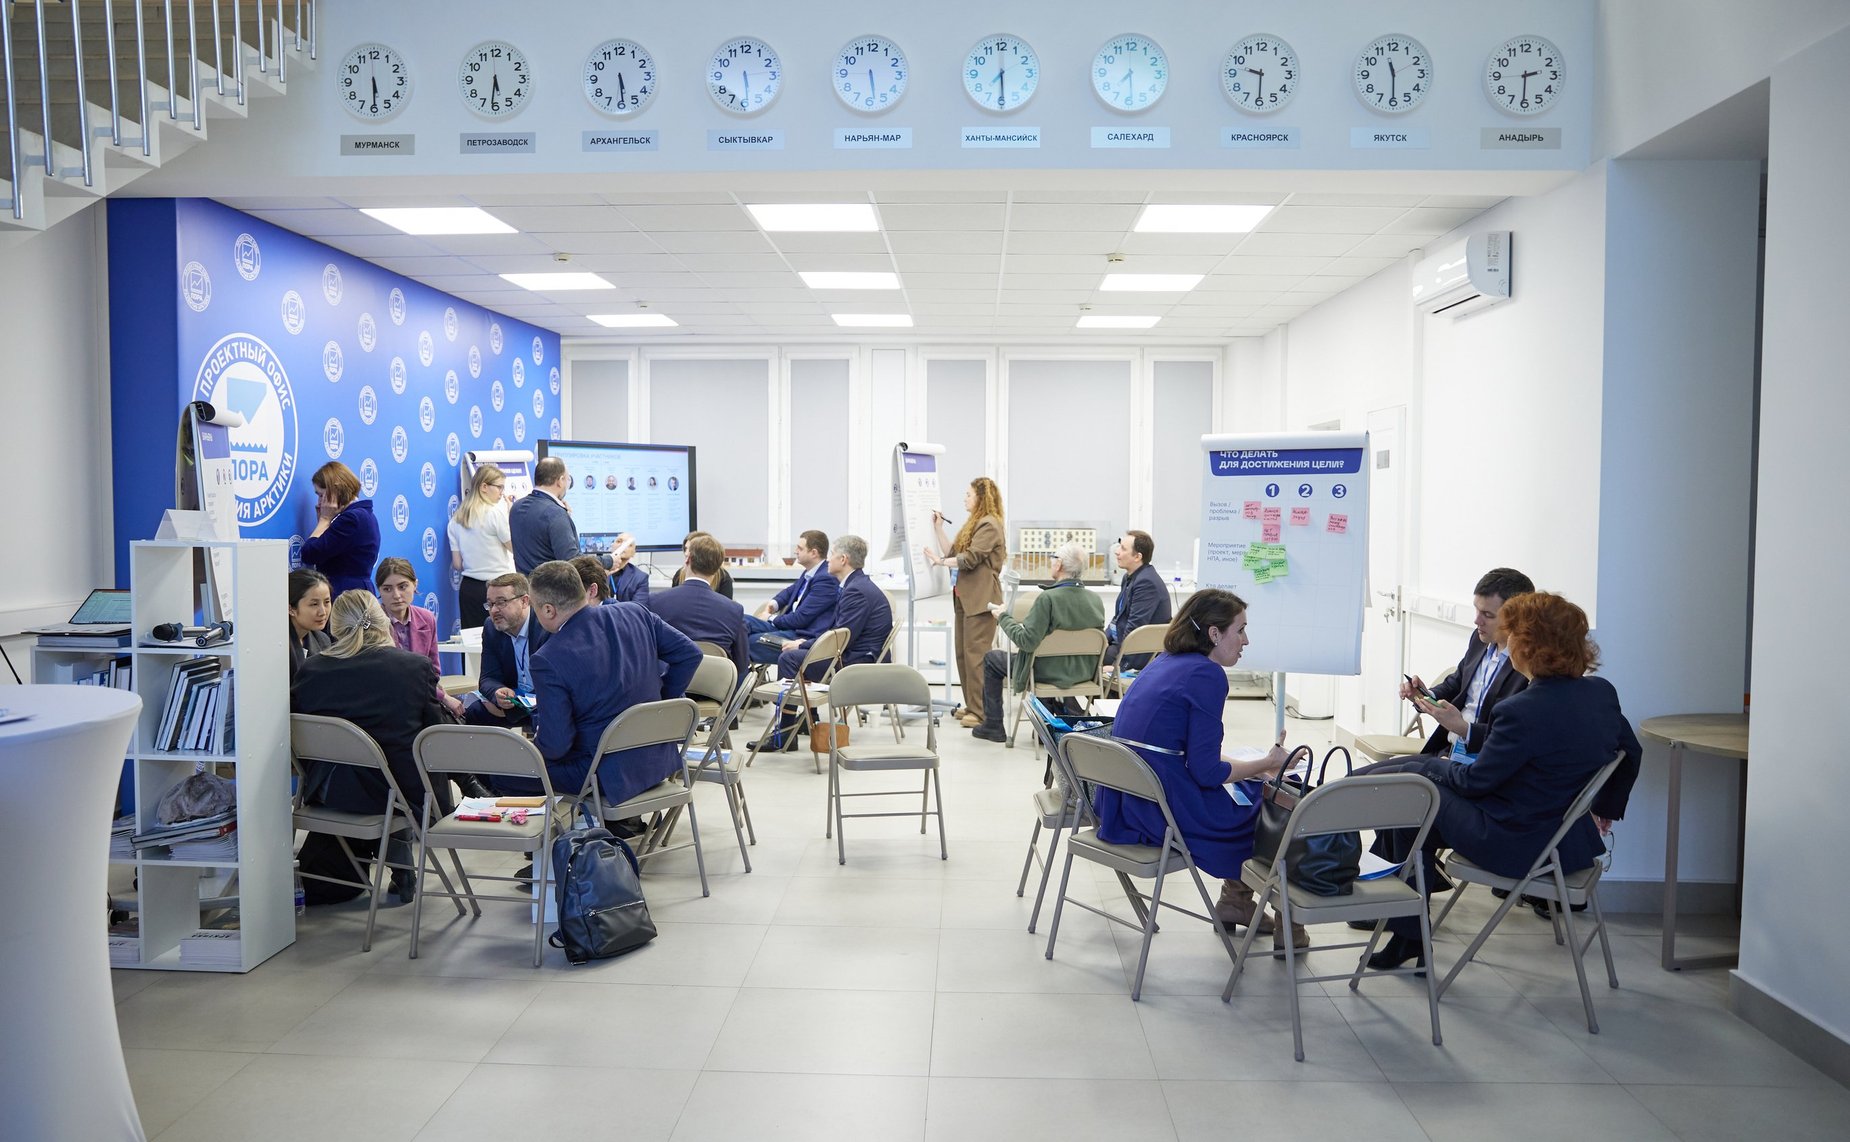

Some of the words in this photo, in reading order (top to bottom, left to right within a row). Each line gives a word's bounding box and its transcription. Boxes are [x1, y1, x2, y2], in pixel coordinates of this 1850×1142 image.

[614, 46, 625, 55] 12
[740, 44, 751, 53] 12
[855, 47, 863, 55] 11
[867, 43, 878, 52] 12
[984, 46, 992, 55] 11
[996, 42, 1007, 51] 12
[1013, 46, 1017, 55] 1
[1113, 45, 1122, 54] 11
[1125, 42, 1137, 51] 12
[1143, 46, 1147, 56] 1
[1244, 46, 1252, 55] 11
[1256, 42, 1267, 51] 12
[1387, 42, 1399, 51] 12
[1404, 46, 1408, 55] 1
[1520, 43, 1531, 52] 12
[368, 51, 380, 60] 12
[490, 48, 501, 57] 12
[602, 52, 611, 60] 11
[631, 50, 635, 59] 1
[728, 49, 736, 58] 11
[757, 49, 761, 57] 1
[884, 48, 888, 56] 1
[1273, 47, 1277, 56] 1
[1375, 47, 1384, 56] 11
[1507, 48, 1516, 57] 11
[1537, 48, 1541, 56] 1
[358, 55, 365, 64] 11
[385, 54, 389, 63] 1
[479, 53, 487, 62] 11
[507, 52, 510, 61] 1
[845, 56, 856, 65] 10
[974, 56, 985, 65] 10
[1021, 56, 1028, 65] 2
[1103, 55, 1114, 64] 10
[1233, 56, 1245, 65] 10
[1413, 56, 1420, 65] 2
[639, 59, 646, 68] 2
[718, 58, 730, 68] 10
[764, 58, 772, 67] 2
[891, 58, 898, 67] 2
[1150, 57, 1158, 66] 2
[1281, 57, 1288, 66] 2
[1365, 57, 1377, 66] 10
[1497, 58, 1509, 67] 10
[1545, 58, 1552, 67] 2
[348, 65, 359, 74] 10
[392, 64, 399, 73] 2
[469, 63, 480, 72] 10
[514, 62, 521, 71] 2
[593, 62, 604, 71] 10
[644, 72, 651, 81] 3
[714, 72, 722, 80] 9
[769, 71, 776, 80] 3
[840, 69, 848, 78] 9
[895, 71, 903, 80] 3
[969, 69, 978, 79] 9
[1026, 68, 1034, 78] 3
[1098, 68, 1107, 78] 9
[1154, 70, 1163, 79] 3
[1228, 68, 1237, 78] 9
[1285, 70, 1292, 80] 3
[1361, 70, 1369, 79] 9
[1418, 69, 1425, 78] 3
[1492, 71, 1501, 81] 9
[1550, 71, 1558, 80] 3
[344, 78, 352, 87] 9
[397, 77, 404, 86] 3
[465, 76, 473, 85] 9
[519, 75, 526, 84] 3
[590, 75, 598, 84] 9
[640, 86, 648, 94] 4
[719, 86, 726, 94] 8
[843, 82, 851, 92] 8
[889, 85, 897, 94] 4
[975, 83, 982, 92] 8
[1020, 82, 1029, 92] 4
[1102, 82, 1111, 91] 8
[1233, 82, 1241, 92] 8
[1279, 84, 1287, 93] 4
[1366, 84, 1374, 93] 8
[1412, 83, 1421, 92] 4
[1497, 85, 1505, 94] 8
[1544, 85, 1553, 94] 4
[349, 91, 356, 100] 8
[392, 90, 400, 99] 4
[470, 89, 477, 98] 8
[514, 88, 522, 97] 4
[595, 88, 603, 97] 8
[854, 92, 861, 102] 7
[985, 92, 992, 102] 7
[1112, 92, 1120, 101] 7
[1243, 92, 1250, 102] 7
[605, 97, 612, 106] 7
[631, 95, 638, 104] 5
[729, 94, 735, 104] 7
[754, 94, 763, 104] 5
[865, 96, 874, 106] 6
[880, 93, 888, 102] 5
[998, 96, 1005, 106] 6
[1124, 96, 1133, 106] 6
[1255, 97, 1264, 106] 6
[1270, 93, 1277, 102] 5
[1376, 93, 1384, 103] 7
[1389, 96, 1398, 107] 6
[1403, 93, 1411, 102] 5
[1508, 95, 1515, 104] 7
[1535, 94, 1543, 104] 5
[359, 100, 365, 109] 7
[384, 100, 391, 109] 5
[480, 98, 486, 107] 7
[491, 101, 500, 111] 6
[505, 98, 512, 107] 5
[617, 100, 626, 110] 6
[740, 97, 749, 108] 6
[1520, 98, 1529, 108] 6
[370, 103, 378, 113] 6
[590, 136, 651, 145] АРХАНГЕЛЬСК
[718, 136, 773, 144] СЫКТЫВКАР
[844, 134, 901, 142] НАРЬЯН-МАР
[965, 134, 1038, 142] ХАНТЫ-МАНСИЙСК
[1107, 133, 1154, 142] САЛЕХАРД
[1231, 133, 1289, 142] КРАСНОЯРСК
[1373, 134, 1407, 142] ЯКУТСК
[1498, 133, 1544, 142] АНАДЫРЬ
[354, 141, 400, 149] МУРМАНСК
[467, 139, 528, 147] ПЕТРОЗАВОДСК
[200, 342, 266, 397] ПРОЕКТНЫЙ
[267, 362, 290, 410] ОФИС
[1241, 450, 1278, 459] ДЕЛАТЬ
[1219, 461, 1239, 469] ДЛЯ
[1241, 460, 1310, 469] ДОСТИЖЕНИЯ
[1312, 460, 1344, 469] ЦЕЛИ?
[254, 452, 293, 519] АРКТИКИ
[1269, 486, 1276, 496] 1
[1301, 486, 1310, 497] 2
[1335, 486, 1344, 497] 3
